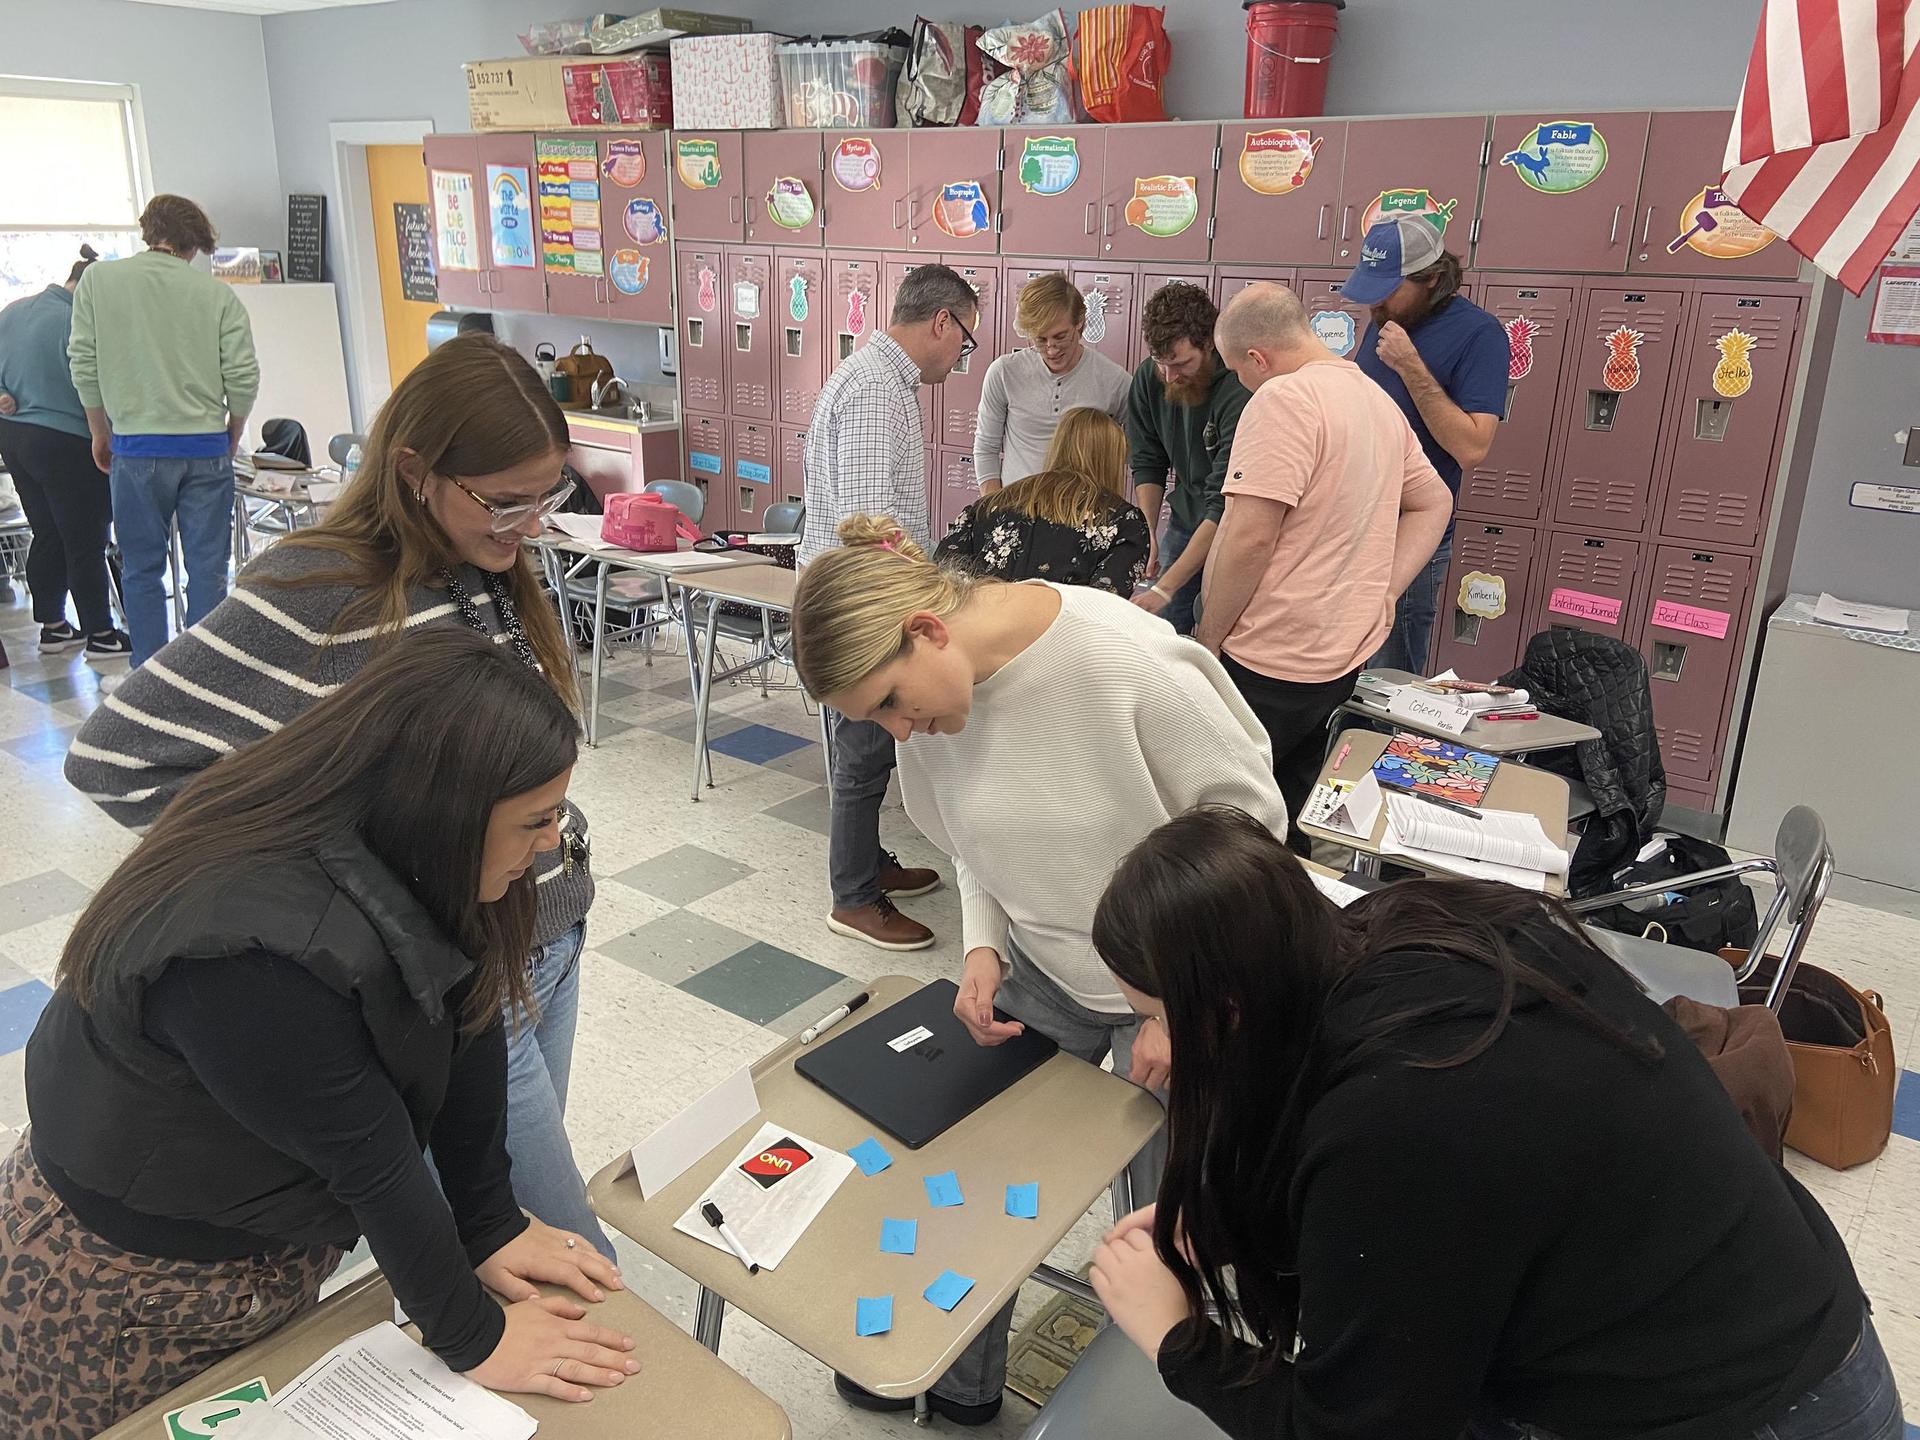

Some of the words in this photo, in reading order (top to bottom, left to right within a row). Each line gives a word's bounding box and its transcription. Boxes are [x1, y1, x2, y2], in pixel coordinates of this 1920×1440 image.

[1551, 130, 1577, 139] Fable
[700, 145, 715, 153] Fiction
[846, 143, 866, 154] Mystery
[1030, 143, 1070, 152] Informational
[780, 181, 792, 193] Fairy
[949, 188, 975, 198] Biography
[1139, 183, 1167, 192] Realistic
[447, 194, 459, 210] Be
[1389, 196, 1418, 207] Legend
[1316, 328, 1346, 342] Supreme
[1718, 365, 1751, 380] Stella
[1467, 587, 1500, 607] Kimberly
[1555, 594, 1585, 616] Writing
[1585, 601, 1619, 619] Journals
[1658, 607, 1677, 623] Red
[1684, 611, 1710, 630] Class
[1408, 699, 1442, 718] Coleen
[1455, 707, 1469, 717] ELA
[760, 1153, 793, 1172] UNO
[408, 1367, 423, 1380] Practice
[429, 1383, 442, 1394] Grade
[440, 1390, 452, 1401] Level
